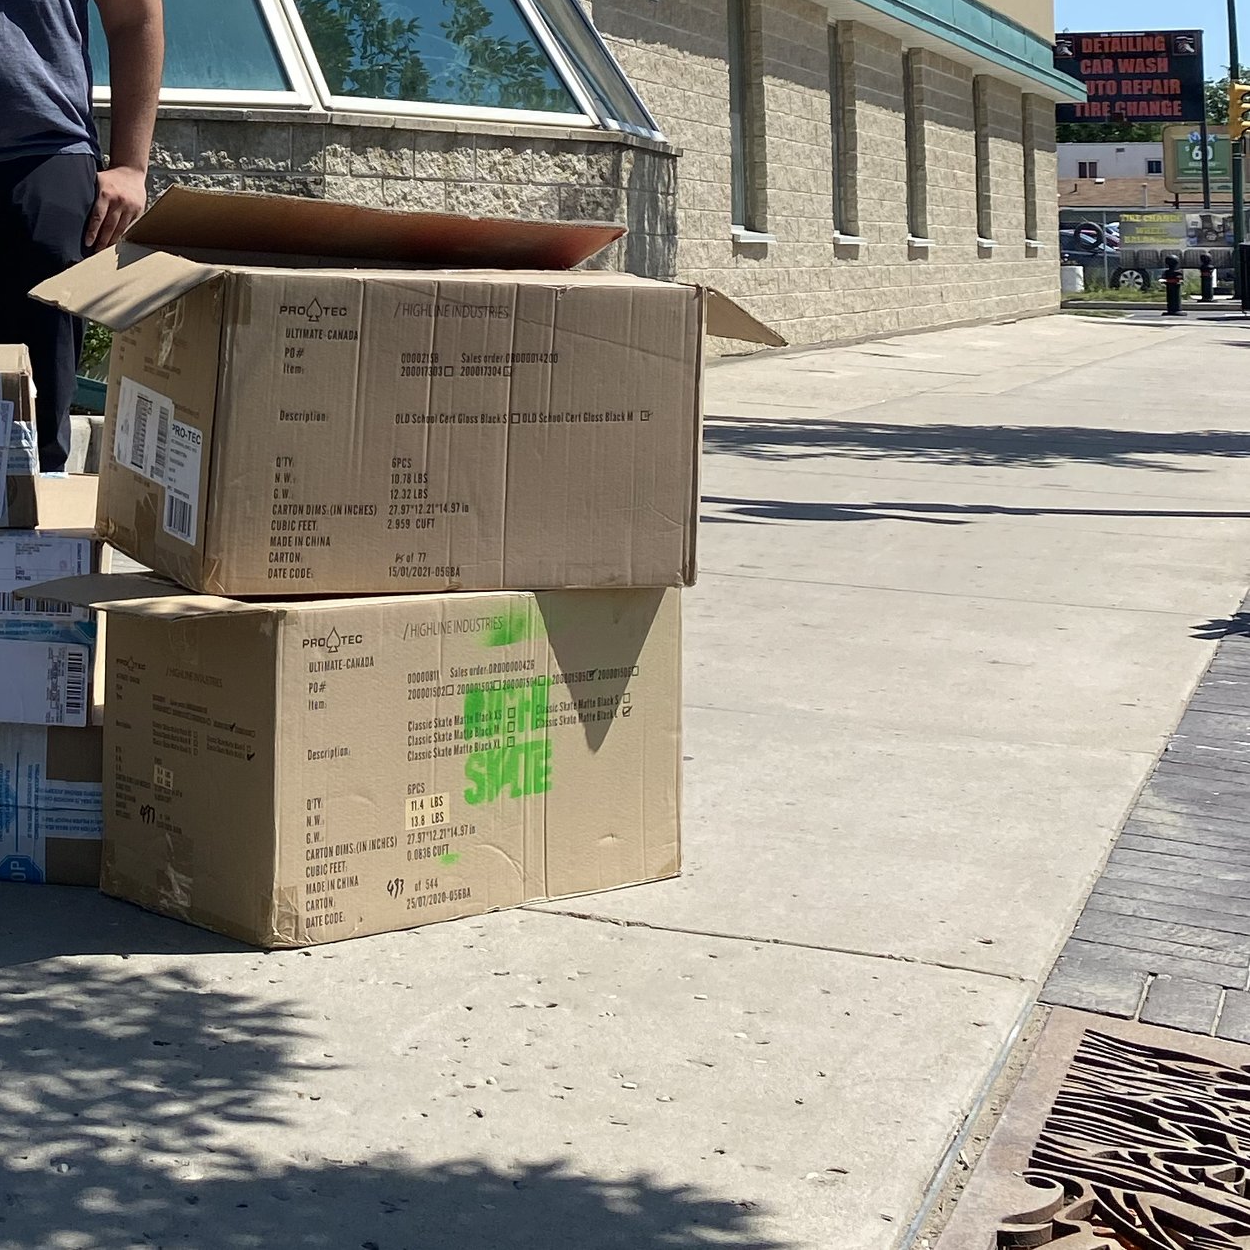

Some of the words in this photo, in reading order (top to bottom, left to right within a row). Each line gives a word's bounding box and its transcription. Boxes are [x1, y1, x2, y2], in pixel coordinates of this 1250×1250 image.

[1081, 36, 1166, 53] DETAILING
[1080, 58, 1114, 75] CAR
[1117, 57, 1169, 74] WASH
[1085, 79, 1117, 95] UTO
[1121, 78, 1181, 94] REPAIR
[1073, 102, 1110, 117] TIRE
[1115, 100, 1182, 116] CHANGE
[451, 303, 509, 319] INDUSTRIES
[284, 348, 304, 358] PO#
[461, 352, 482, 364] Sales
[395, 414, 410, 425] OLD
[411, 414, 438, 425] School
[439, 414, 457, 425] Cert
[458, 413, 478, 424] Gloss
[480, 413, 501, 424] Black
[522, 413, 537, 423] OLD
[538, 413, 564, 423] School
[565, 413, 582, 423] Cert
[583, 412, 604, 423] Gloss
[605, 412, 626, 422] Black
[391, 458, 412, 468] 6PCS
[391, 473, 412, 484] 10.78
[413, 473, 428, 484] LBS
[390, 489, 412, 500] 12.32
[413, 488, 428, 499] LBS
[272, 505, 303, 516] CARTON
[271, 520, 296, 531] CUBIC
[387, 519, 411, 529] 2.959
[415, 518, 435, 529] CUFT
[270, 536, 293, 547] MADE
[294, 536, 304, 547] IN
[305, 536, 331, 547] CHINA
[417, 552, 426, 563] 77
[267, 568, 287, 579] DATE
[453, 616, 503, 633] INDUSTRIES
[309, 656, 374, 673] ULTIMATE-CANADA
[308, 682, 326, 693] PO#
[450, 666, 468, 678] Sales
[535, 702, 558, 715] Classic
[559, 700, 577, 713] Skate
[578, 698, 597, 711] Matte
[598, 696, 614, 708] Black
[408, 719, 433, 732] Classic
[433, 716, 453, 729] Skate
[454, 714, 473, 726] Matte
[474, 711, 493, 723] Black
[535, 716, 558, 728] Classic
[559, 713, 577, 726] Skate
[578, 712, 596, 724] Matte
[597, 710, 614, 721] Black
[407, 734, 432, 747] Classic
[433, 730, 453, 743] Skate
[453, 729, 473, 741] Matte
[474, 726, 493, 738] Black
[407, 749, 432, 762] Classic
[433, 745, 452, 759] Skate
[453, 743, 473, 755] Matte
[474, 741, 493, 753] Black
[407, 783, 425, 795] 6PCS
[411, 800, 424, 811] 11.4
[430, 796, 443, 808] LBS
[411, 815, 425, 828] 13.8
[431, 812, 444, 824] LBS
[306, 846, 334, 861] CARTON
[306, 863, 328, 878] CUBIC
[407, 847, 431, 861] 0.0836
[432, 844, 450, 857] CUFT
[306, 880, 326, 895] MADE
[327, 879, 335, 891] IN
[336, 875, 359, 889] CHINA
[414, 880, 421, 891] of
[425, 878, 439, 890] 544
[306, 915, 324, 928] DATE
